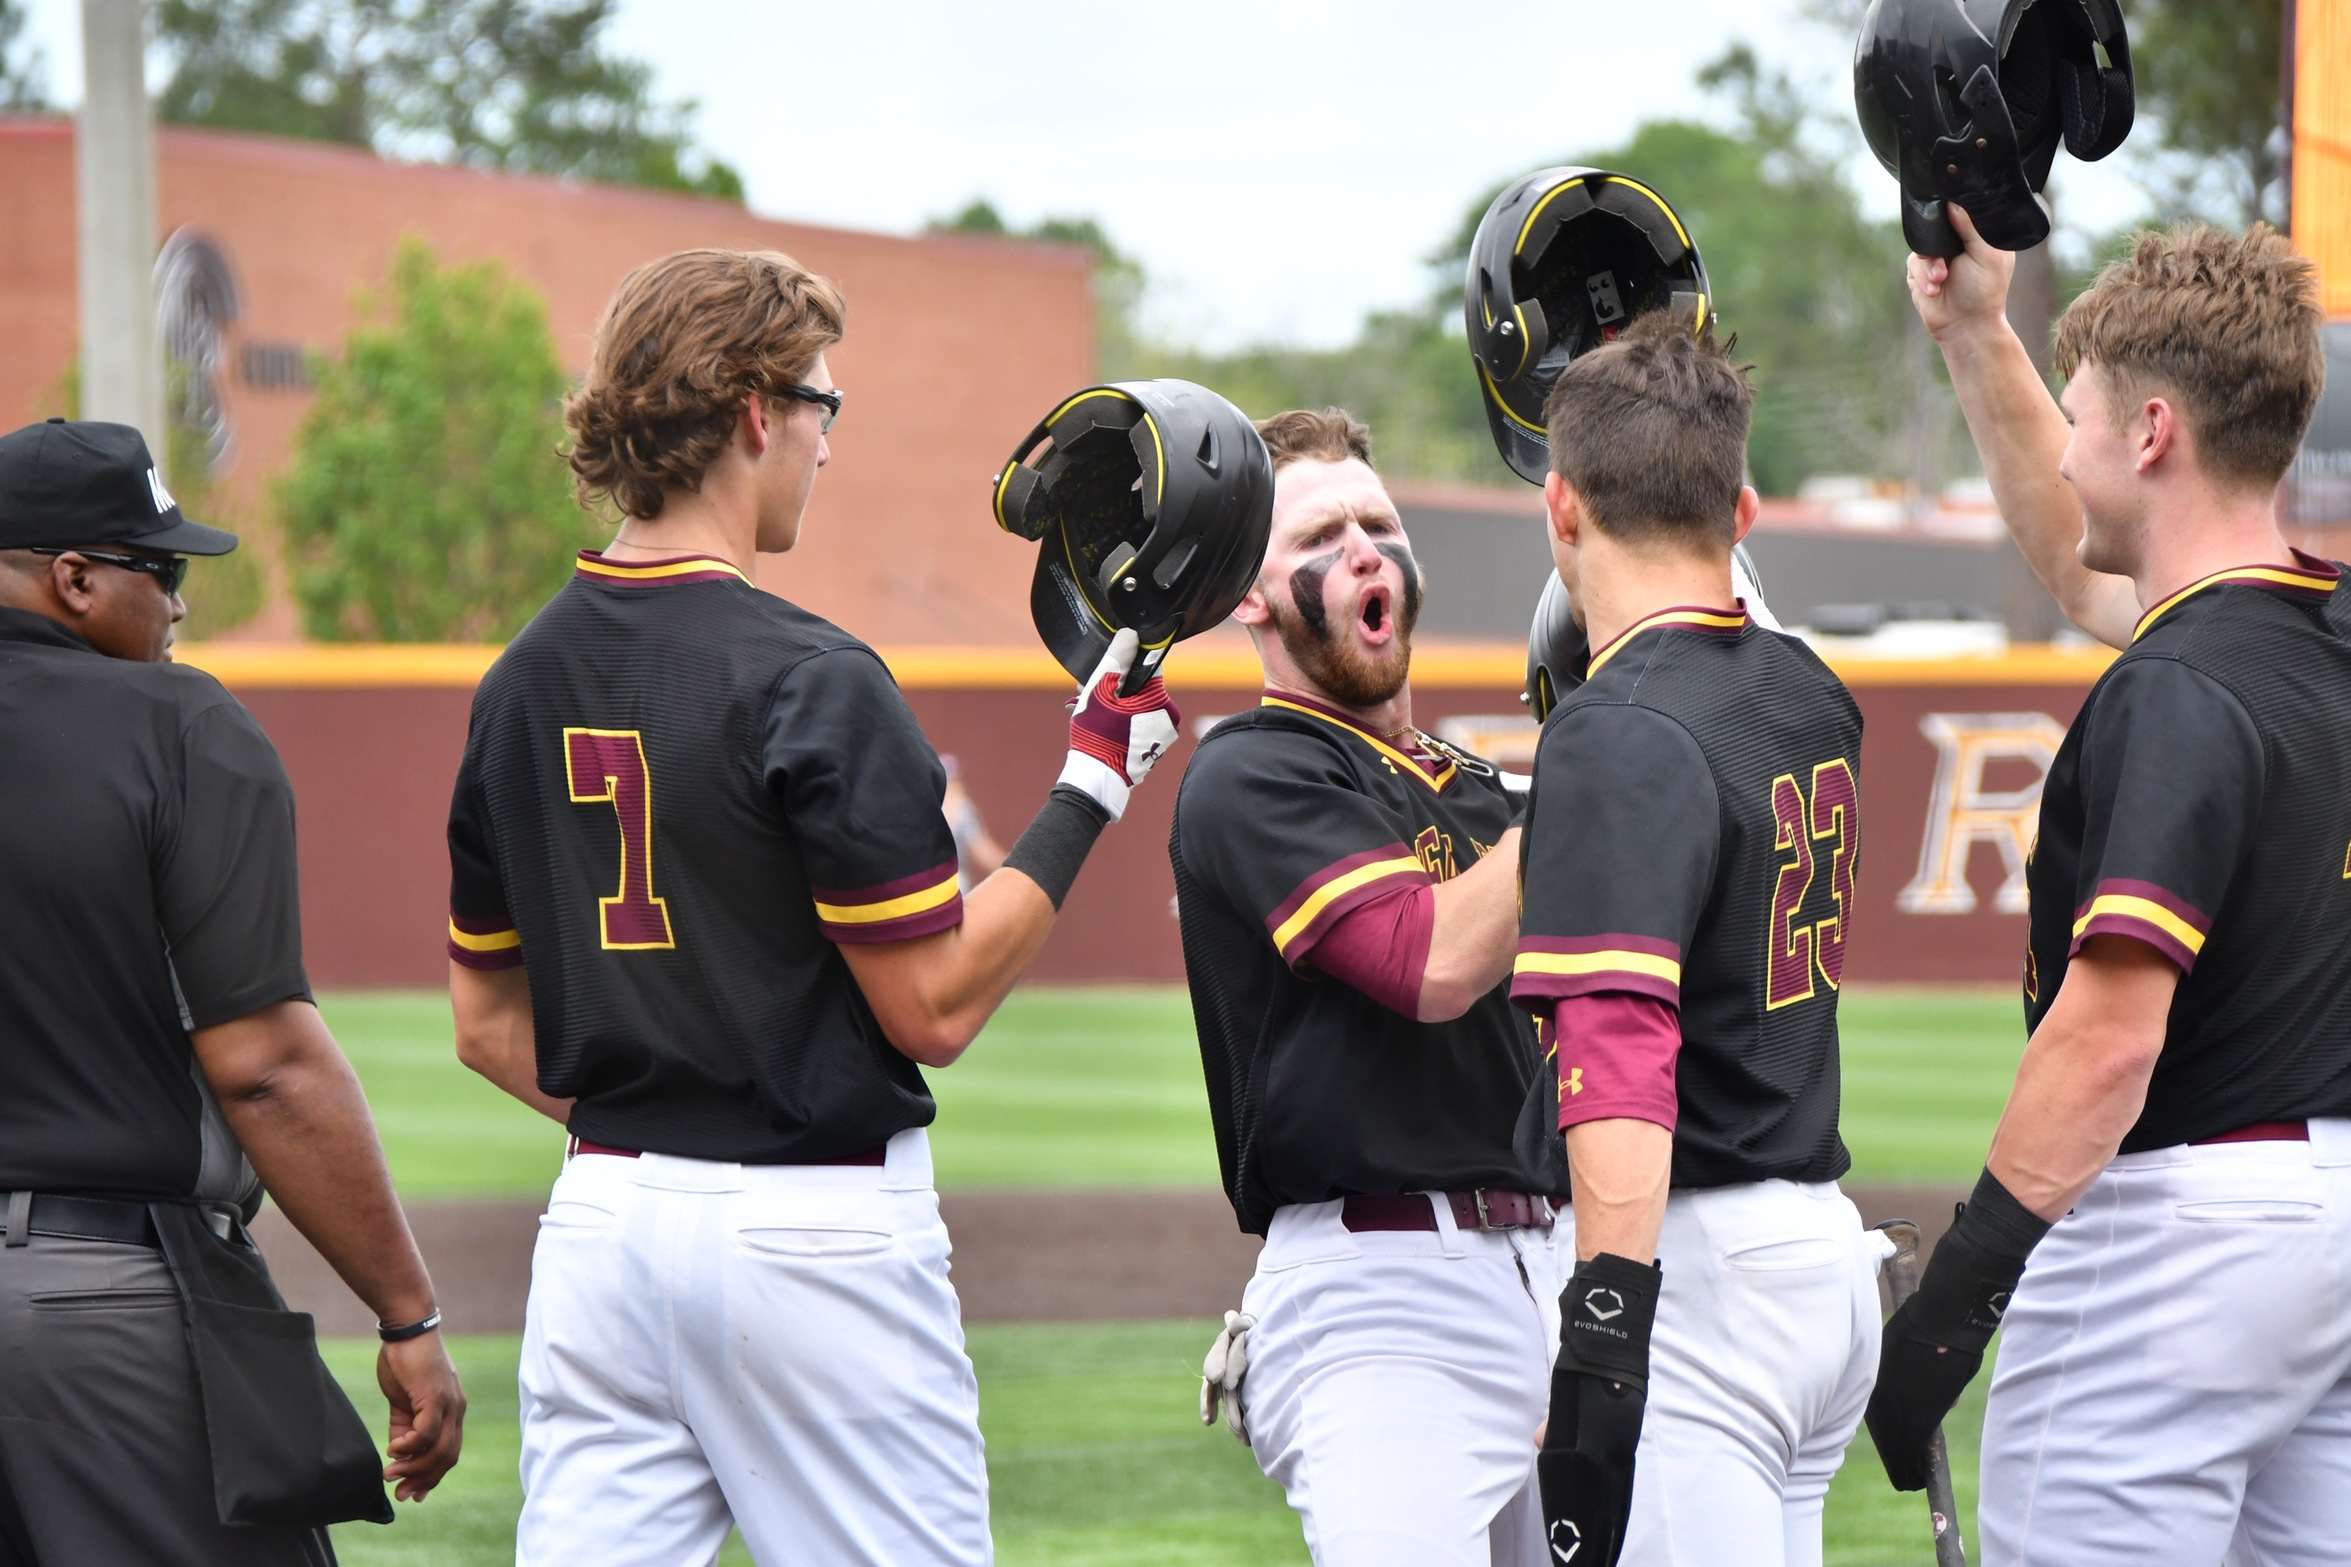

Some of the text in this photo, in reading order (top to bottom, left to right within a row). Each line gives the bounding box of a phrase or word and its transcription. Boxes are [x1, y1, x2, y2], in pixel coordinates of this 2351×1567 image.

[563, 727, 675, 949] 7
[1766, 757, 1858, 1011] 23
[1574, 1320, 1628, 1339] EVOSHIELD
